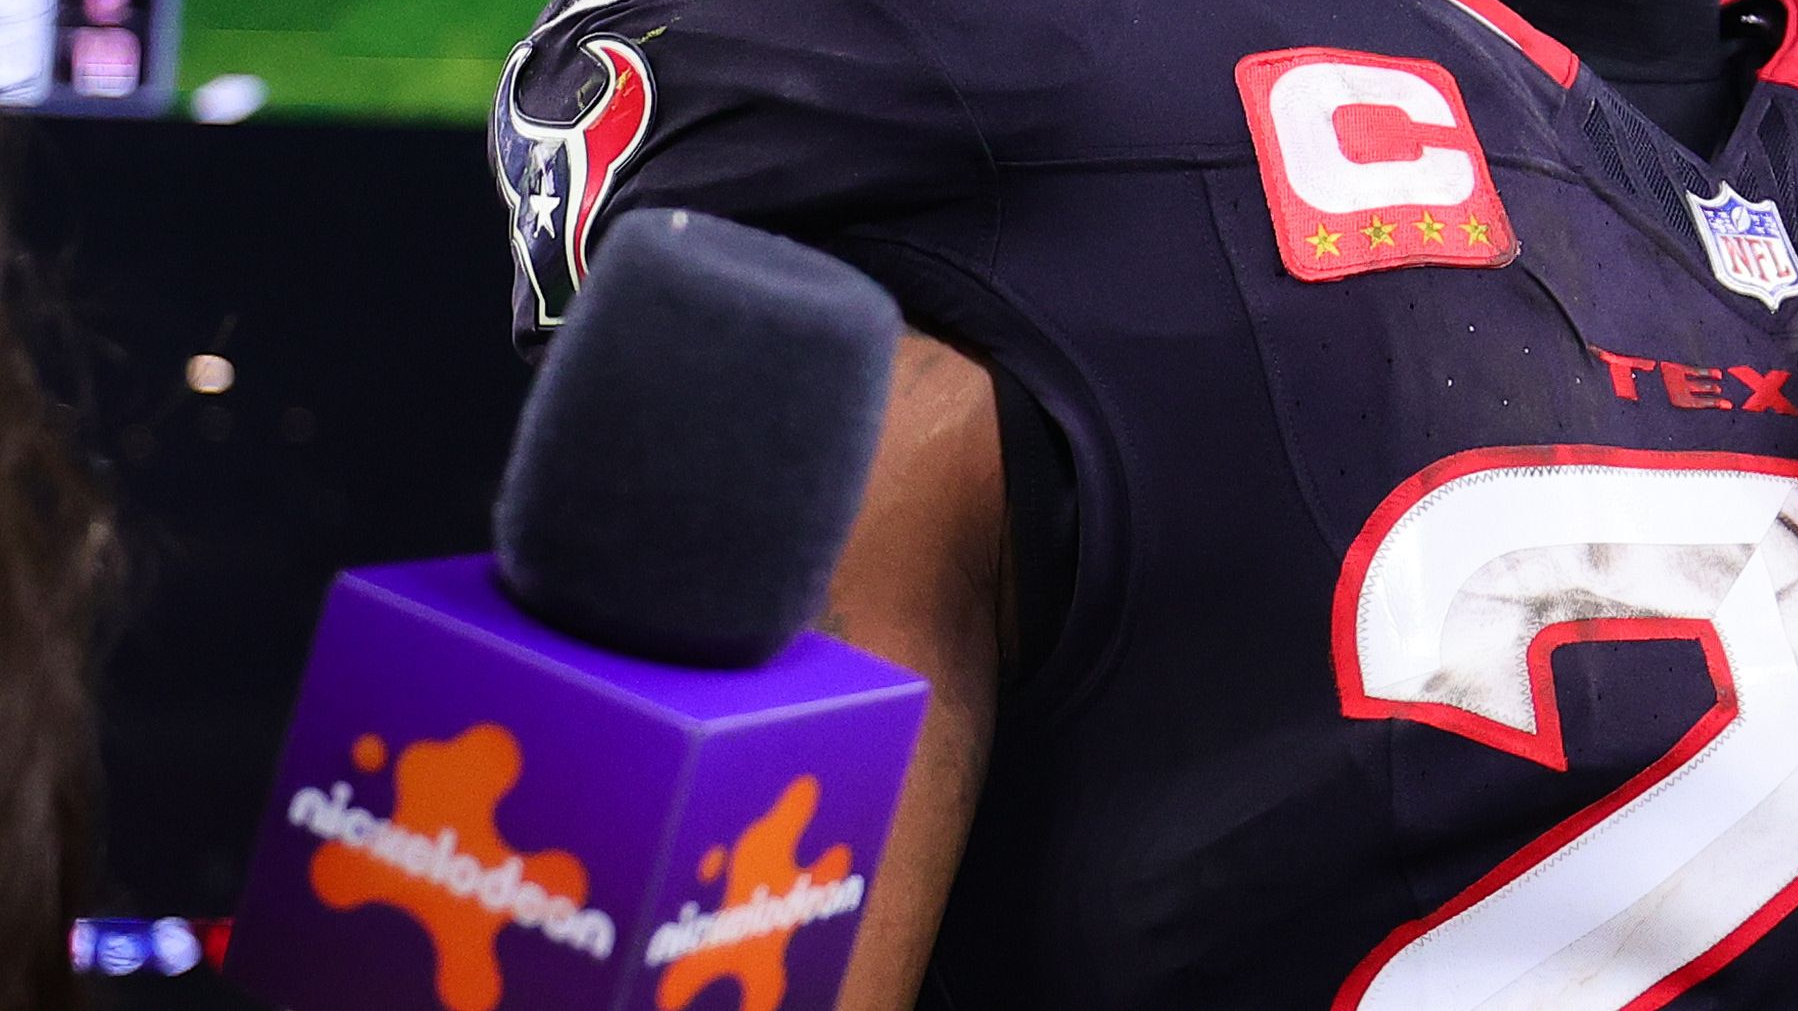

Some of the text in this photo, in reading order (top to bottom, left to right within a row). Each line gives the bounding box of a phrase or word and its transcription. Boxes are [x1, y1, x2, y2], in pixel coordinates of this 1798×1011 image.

[1269, 61, 1475, 214] C
[1720, 235, 1791, 283] NFL
[288, 781, 615, 960] nickelodeon
